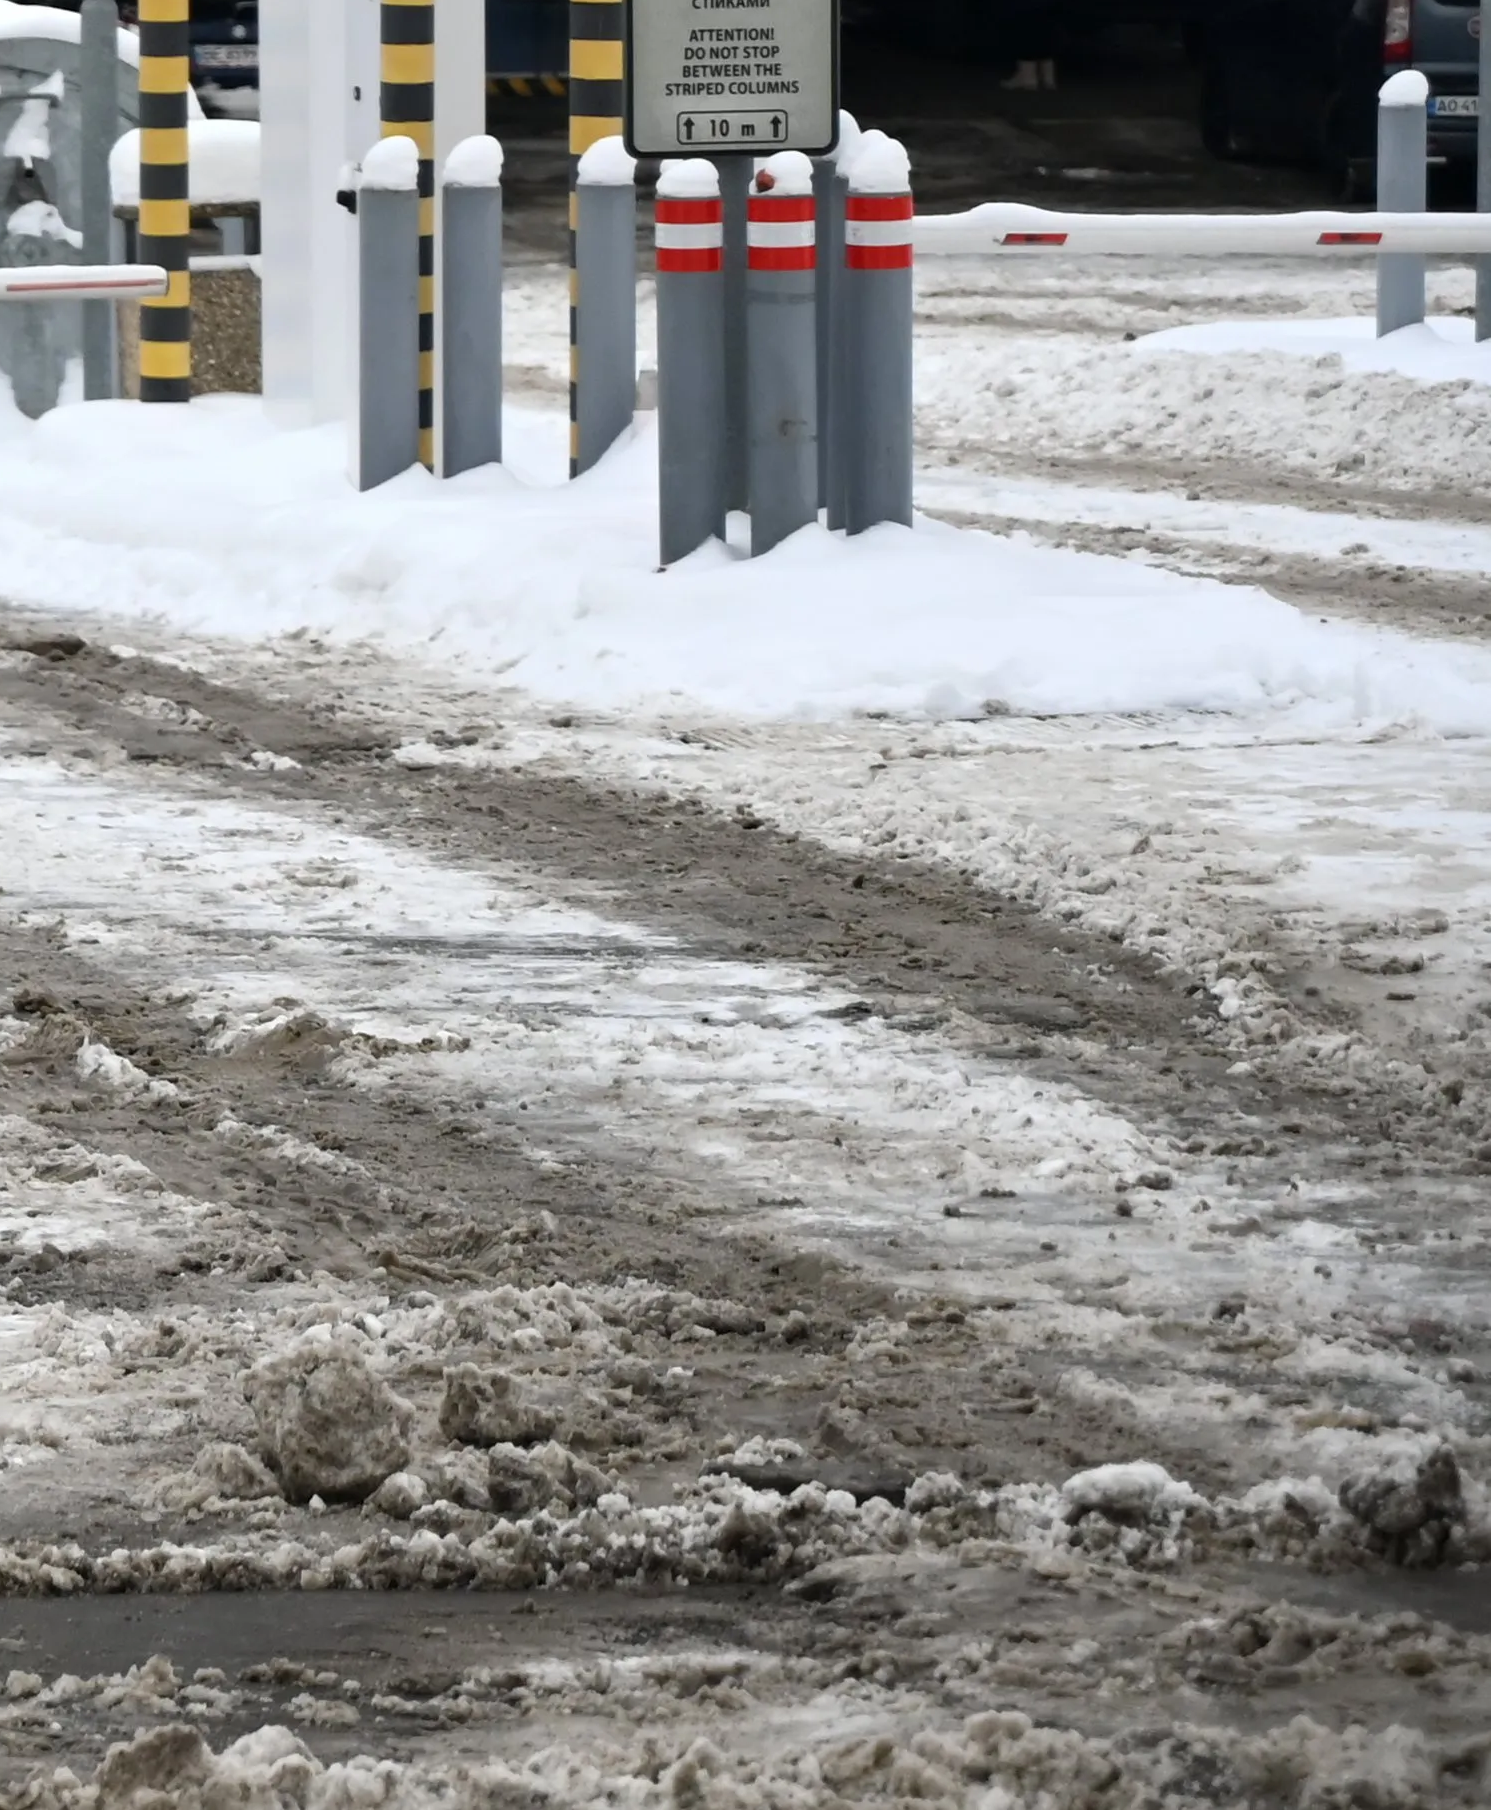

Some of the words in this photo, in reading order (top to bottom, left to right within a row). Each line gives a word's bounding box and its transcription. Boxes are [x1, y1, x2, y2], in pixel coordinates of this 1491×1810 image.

[688, 27, 775, 42] ATTENTION!
[684, 46, 706, 60] DO
[709, 45, 739, 60] NOT
[742, 44, 780, 59] STOP
[682, 63, 751, 78] BETWEEN
[754, 62, 783, 77] THE
[665, 81, 725, 97] STRIPED
[728, 79, 800, 95] COLUMNS
[709, 118, 730, 138] 10
[741, 122, 756, 137] m
